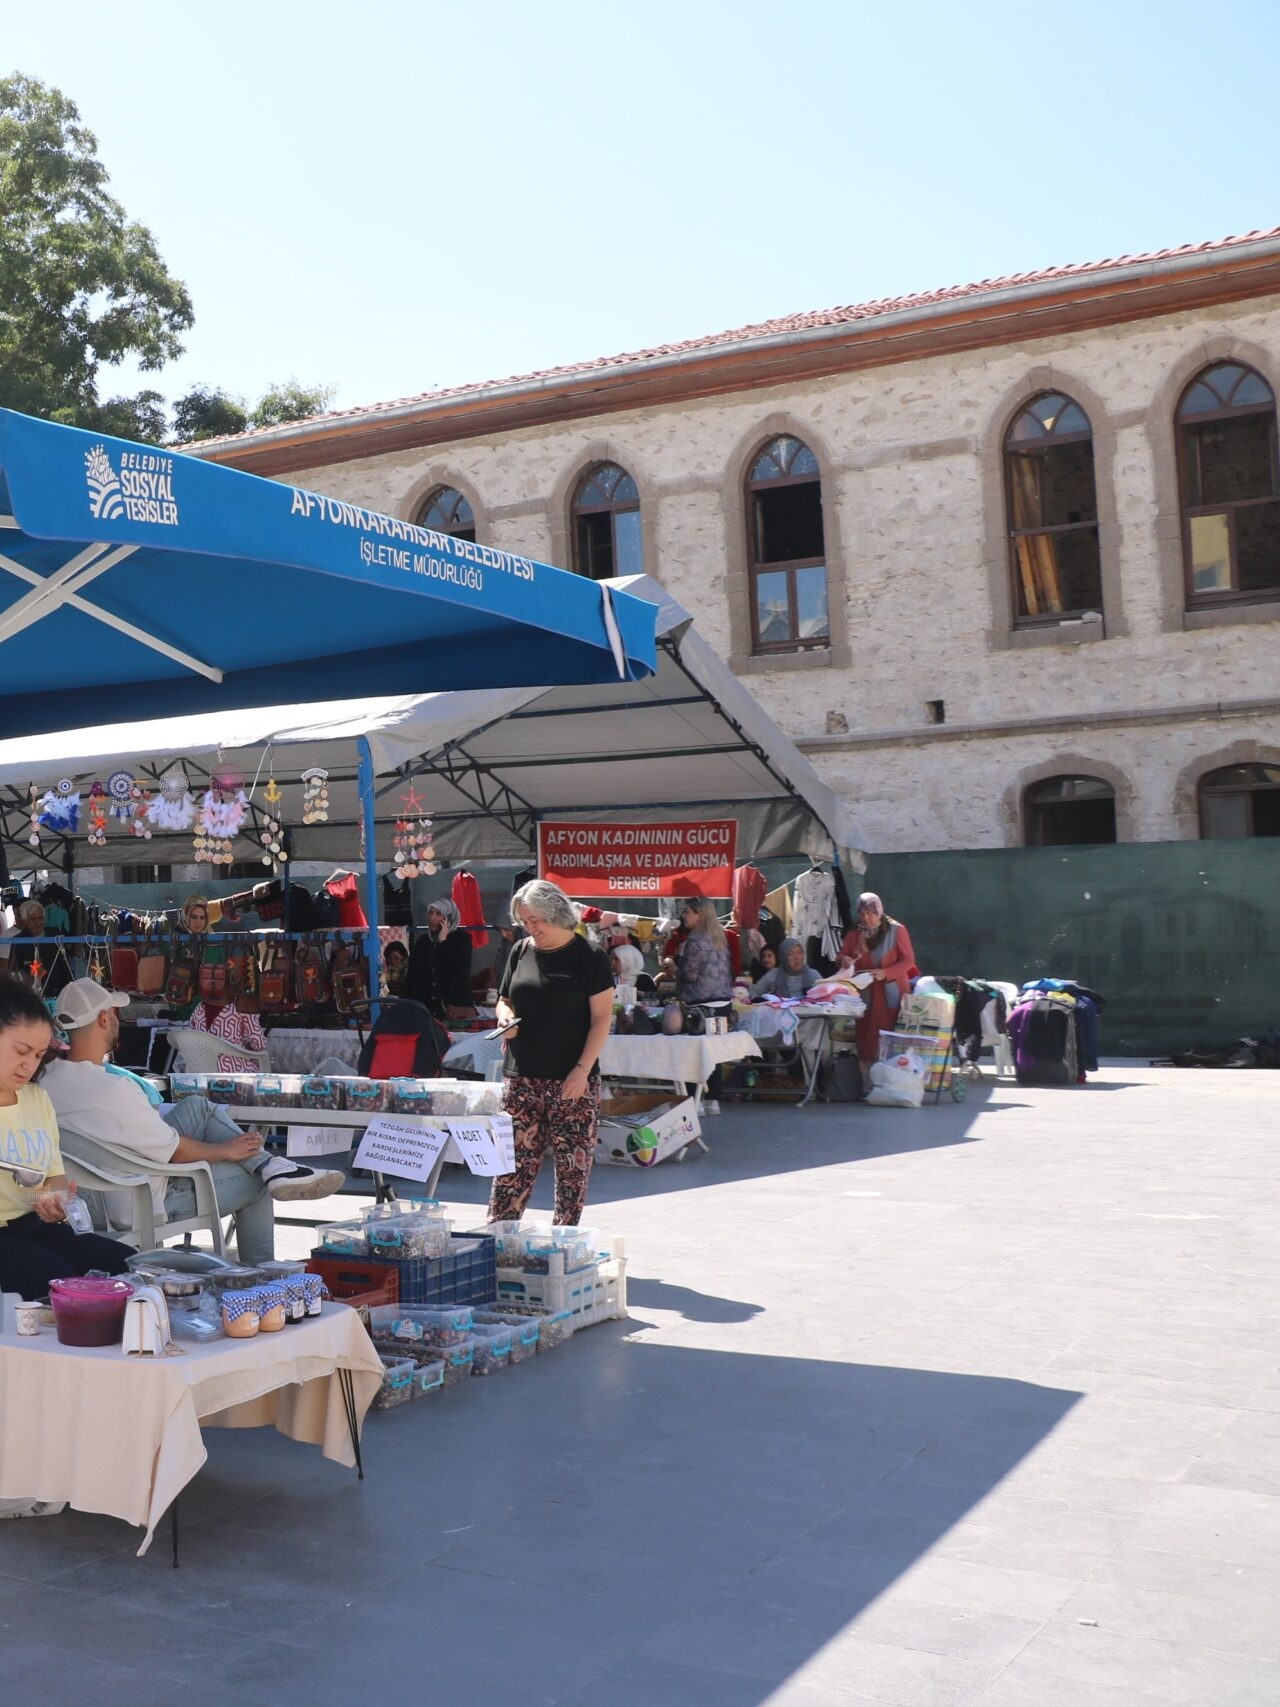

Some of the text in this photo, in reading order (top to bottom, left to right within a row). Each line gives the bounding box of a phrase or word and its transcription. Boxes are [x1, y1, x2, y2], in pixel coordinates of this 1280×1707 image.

[121, 453, 172, 473] BELEDİYE
[121, 470, 175, 501] SOSYAL
[123, 498, 178, 525] TESİSLER
[360, 536, 483, 591] İŞLETME MÜDÜRLÜĞÜ
[547, 825, 730, 845] AFYON KADINININ GÜCÜ
[546, 853, 729, 871] YARDIMLAŞMA VE DAYANIŞMA
[608, 873, 660, 890] DERNEĞİ
[397, 1137, 440, 1153] DEPREMZEDE
[462, 1130, 482, 1142] ADET
[476, 1154, 488, 1166] TL
